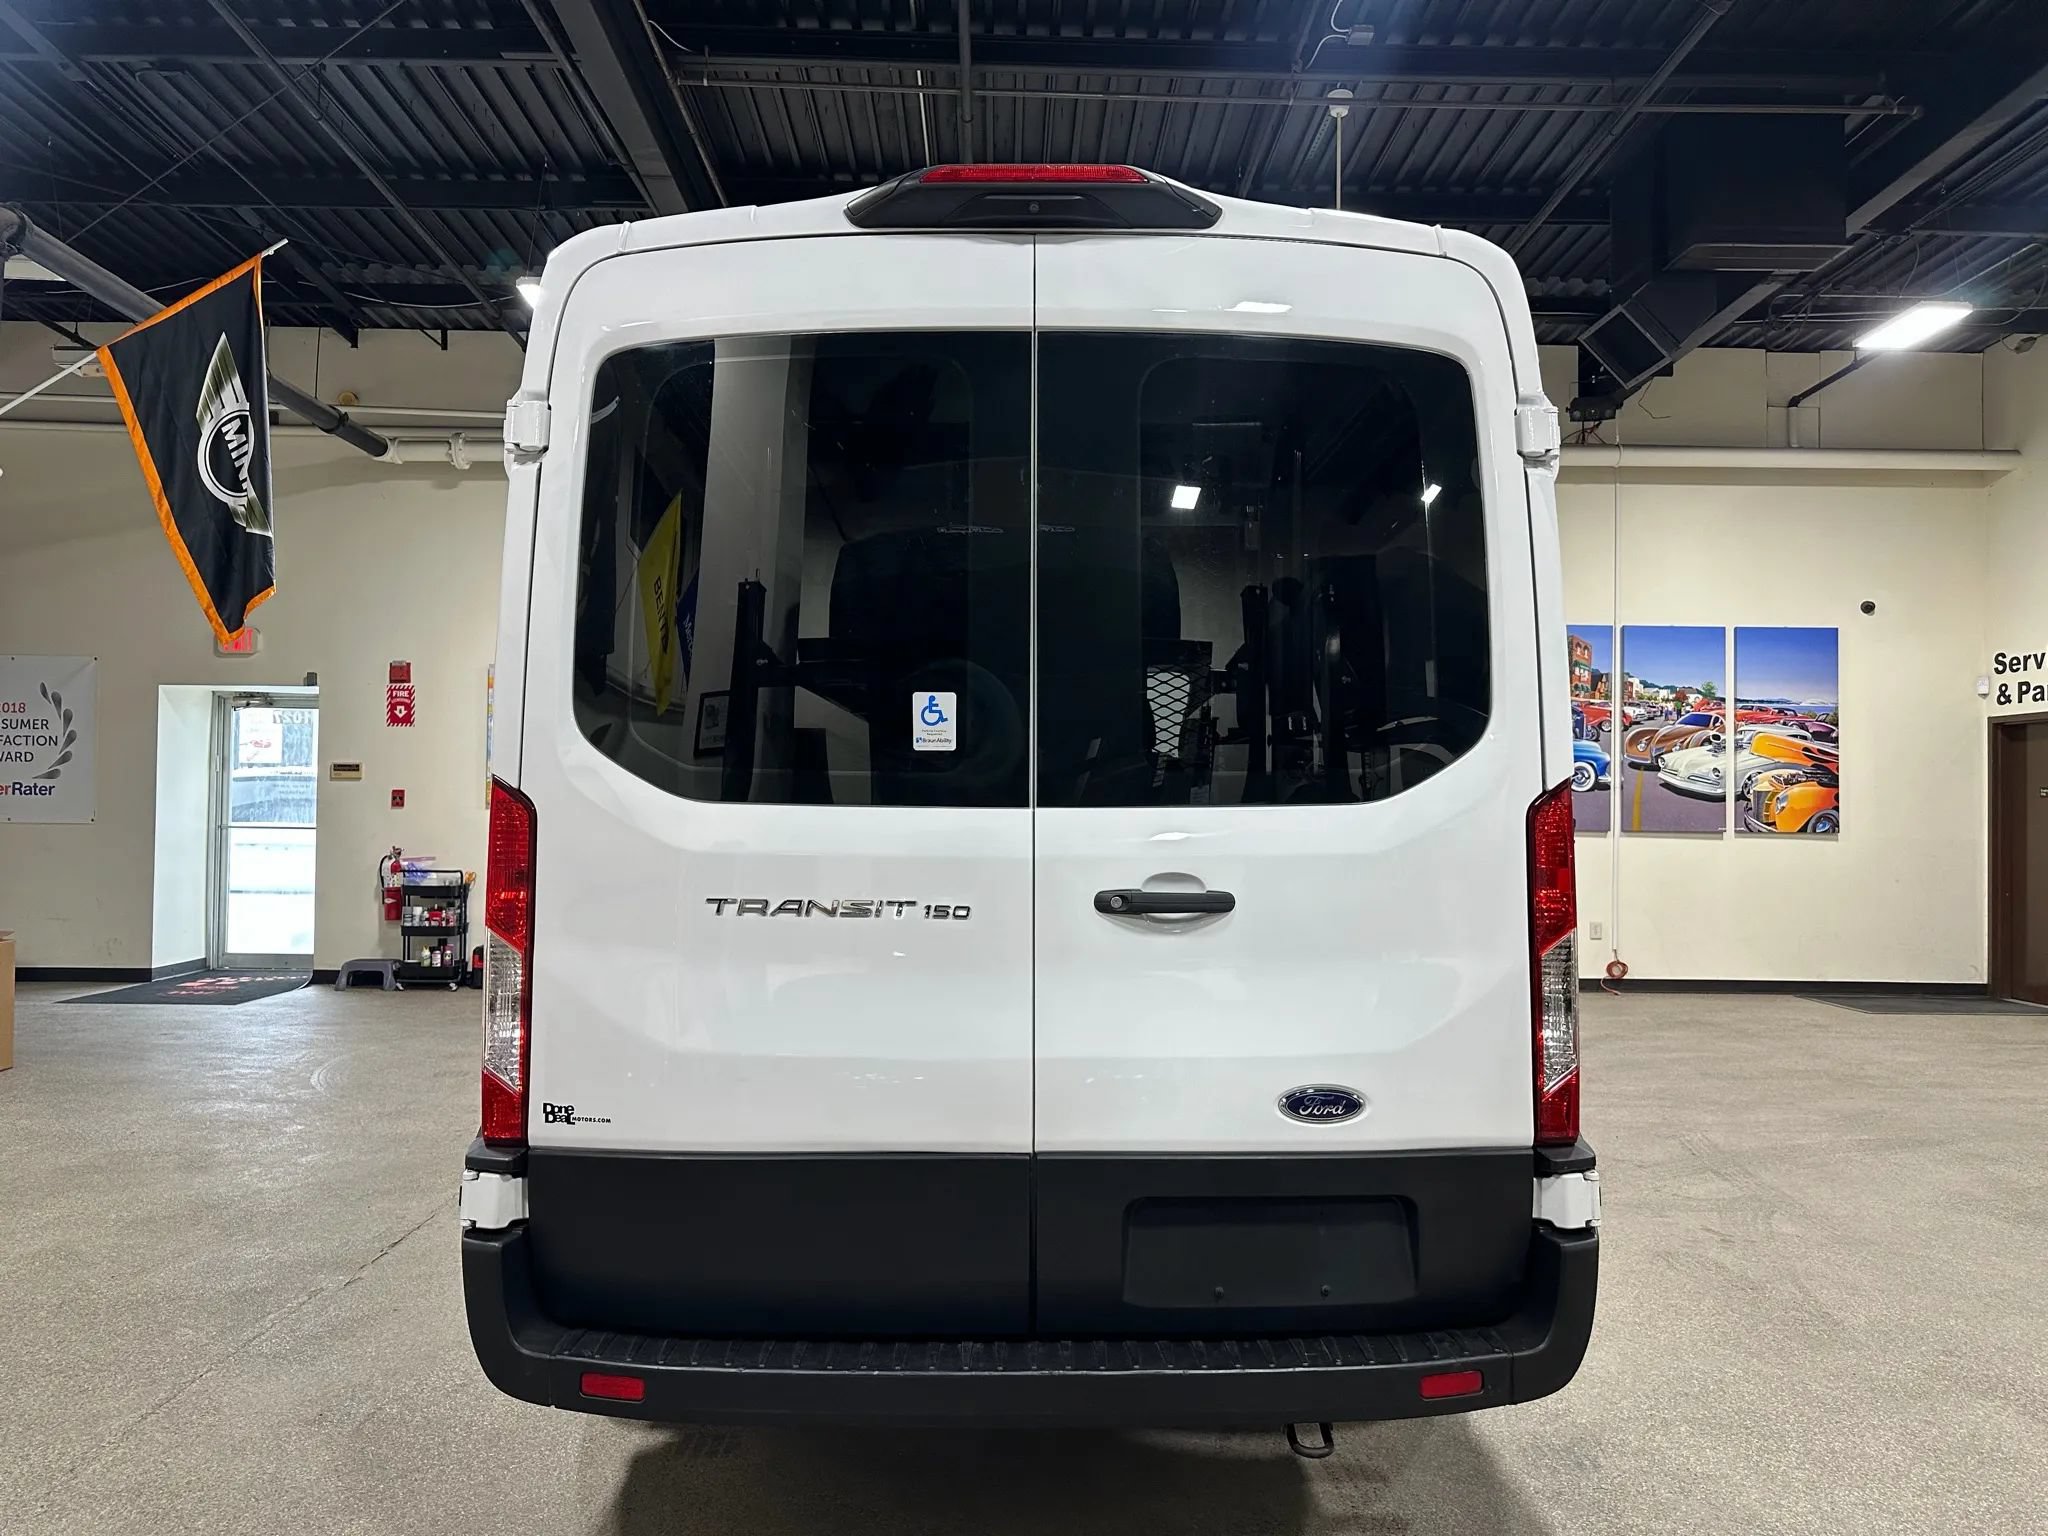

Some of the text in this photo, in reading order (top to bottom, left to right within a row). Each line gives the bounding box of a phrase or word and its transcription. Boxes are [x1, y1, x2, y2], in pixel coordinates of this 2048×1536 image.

[221, 417, 250, 490] MIN
[1993, 652, 2046, 675] Serv
[1996, 681, 2048, 706] & Pa
[0, 702, 26, 714] 018
[1, 718, 49, 730] SUMER
[706, 897, 971, 920] TRANSIT 150
[543, 1102, 575, 1114] Done
[1299, 1095, 1346, 1115] Ford
[571, 1116, 612, 1124] MOTORS.COM
